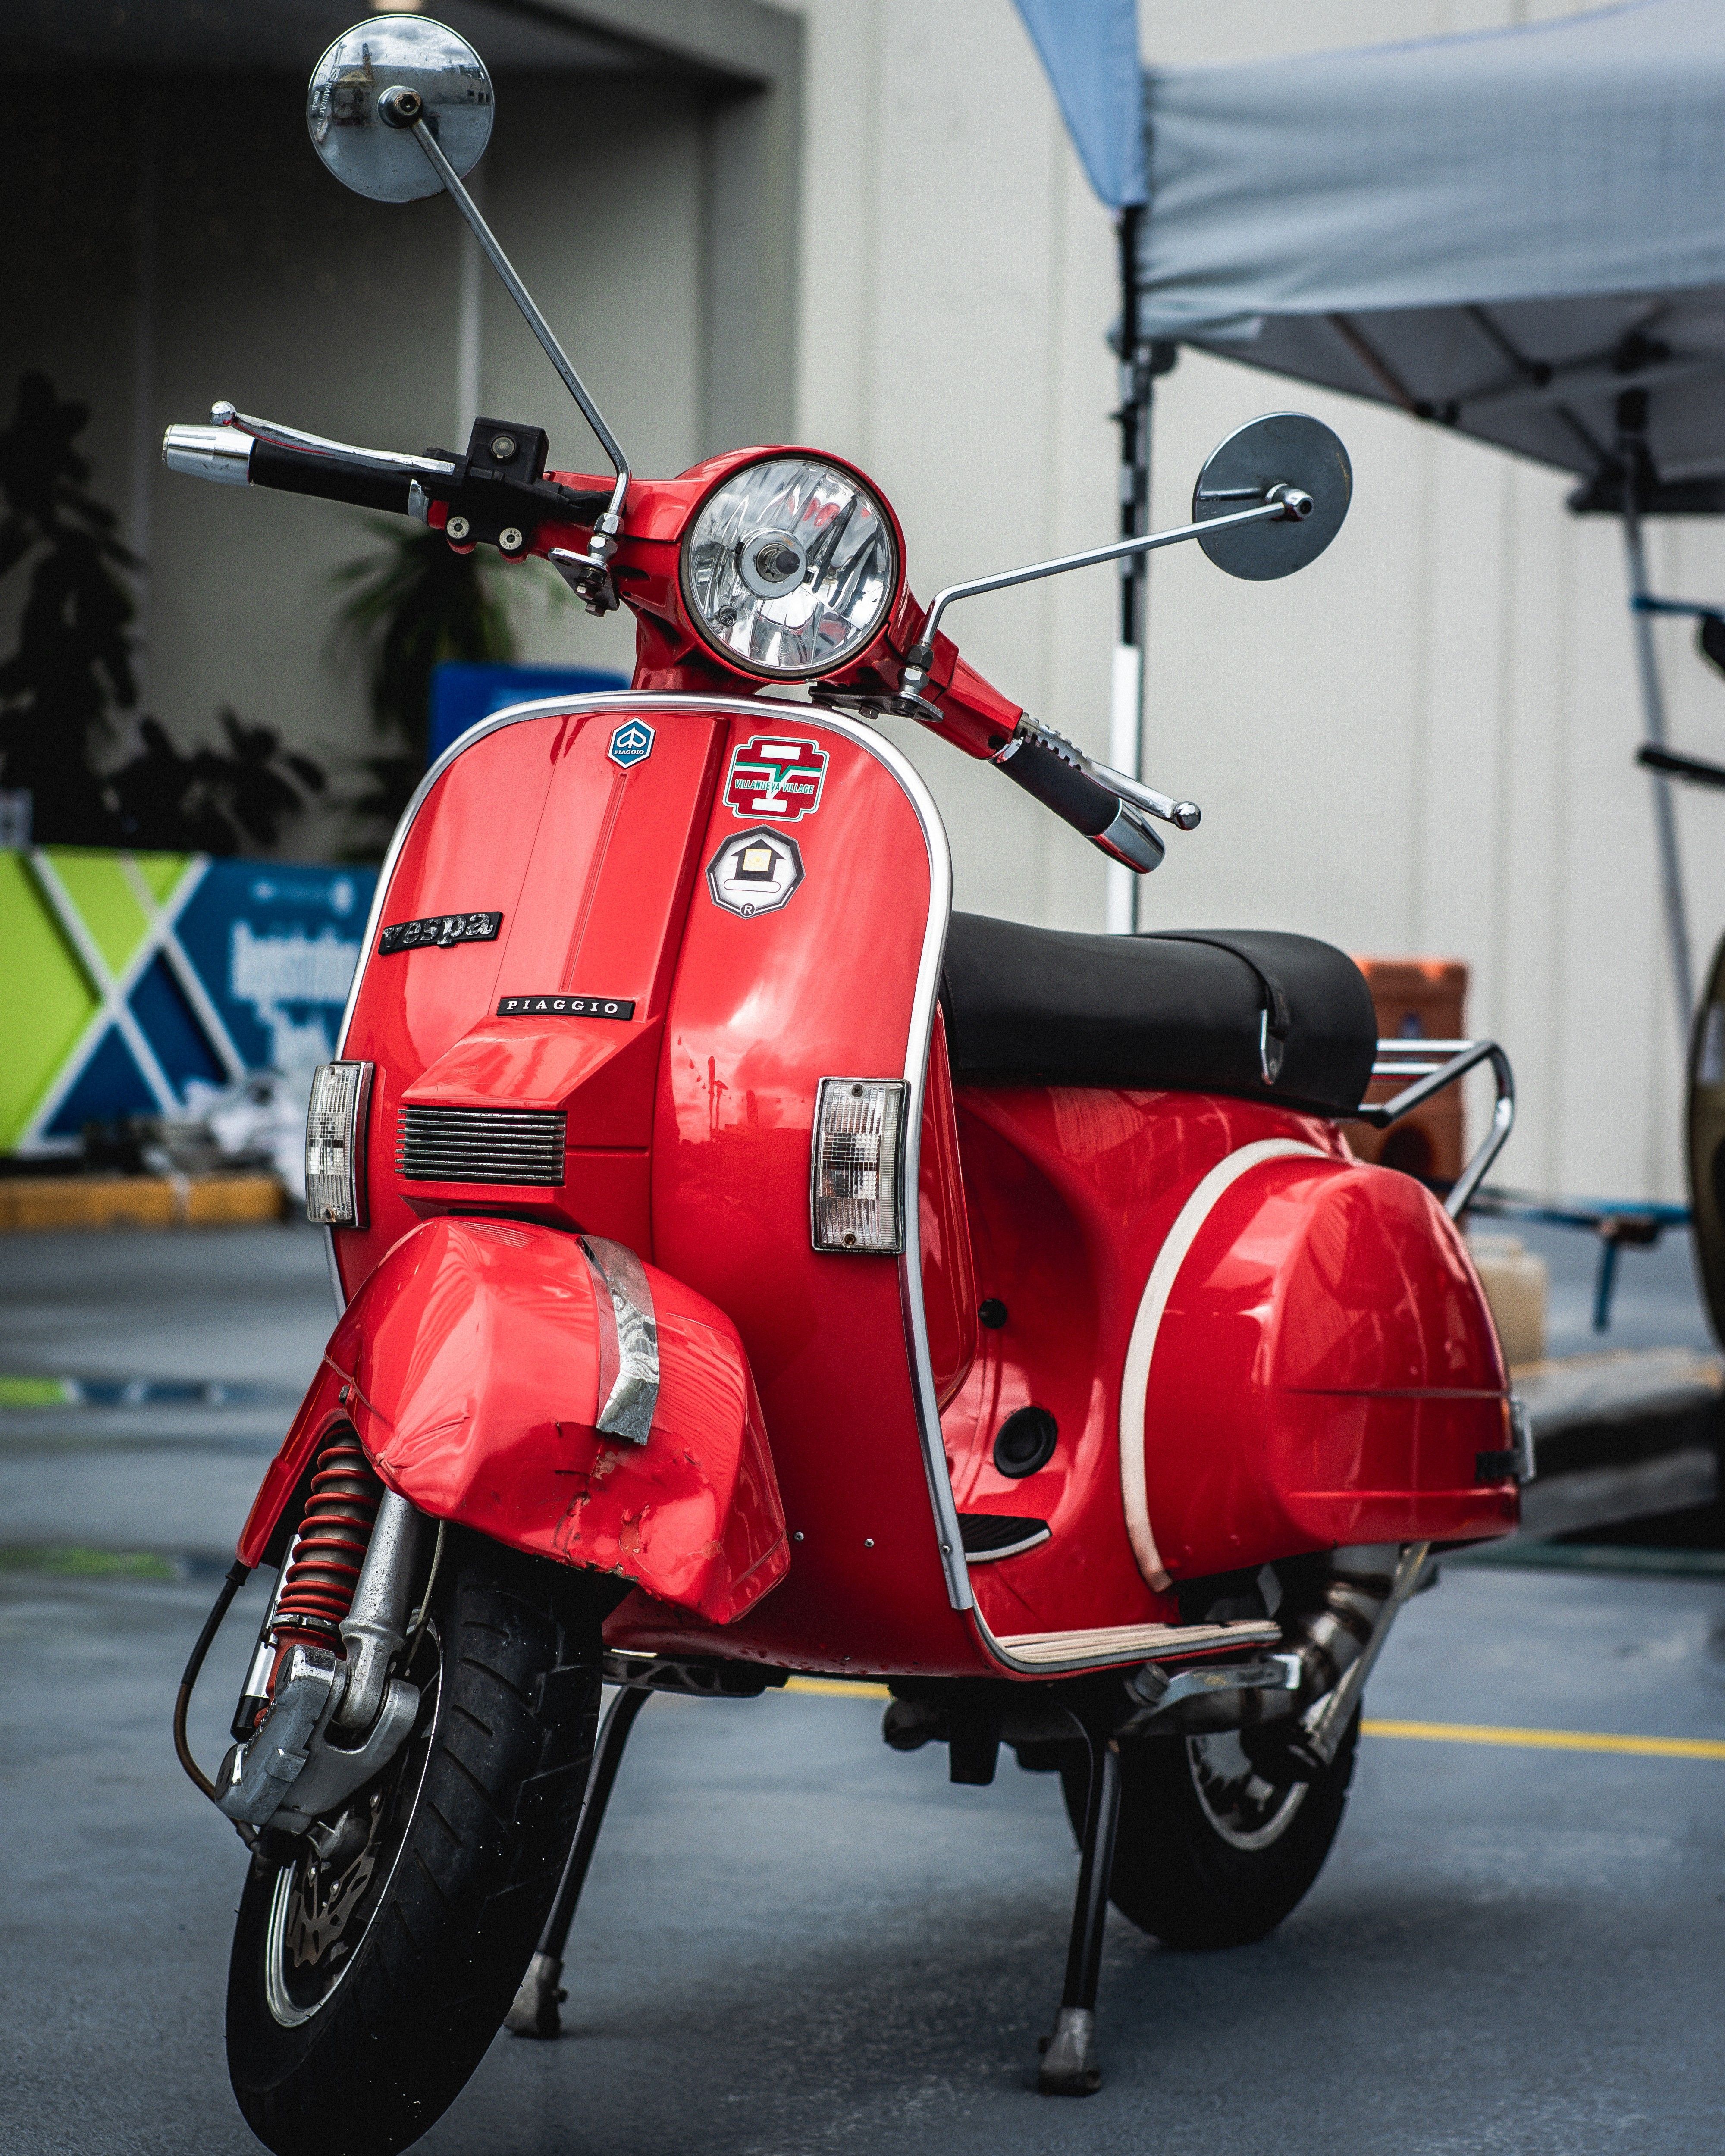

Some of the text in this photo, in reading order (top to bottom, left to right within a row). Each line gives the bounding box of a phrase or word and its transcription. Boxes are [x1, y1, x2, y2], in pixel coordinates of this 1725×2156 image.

[735, 780, 814, 794] VILLANUEVA VILLAGE
[743, 905, 753, 914] R
[507, 1000, 618, 1014] PIAGGIO
